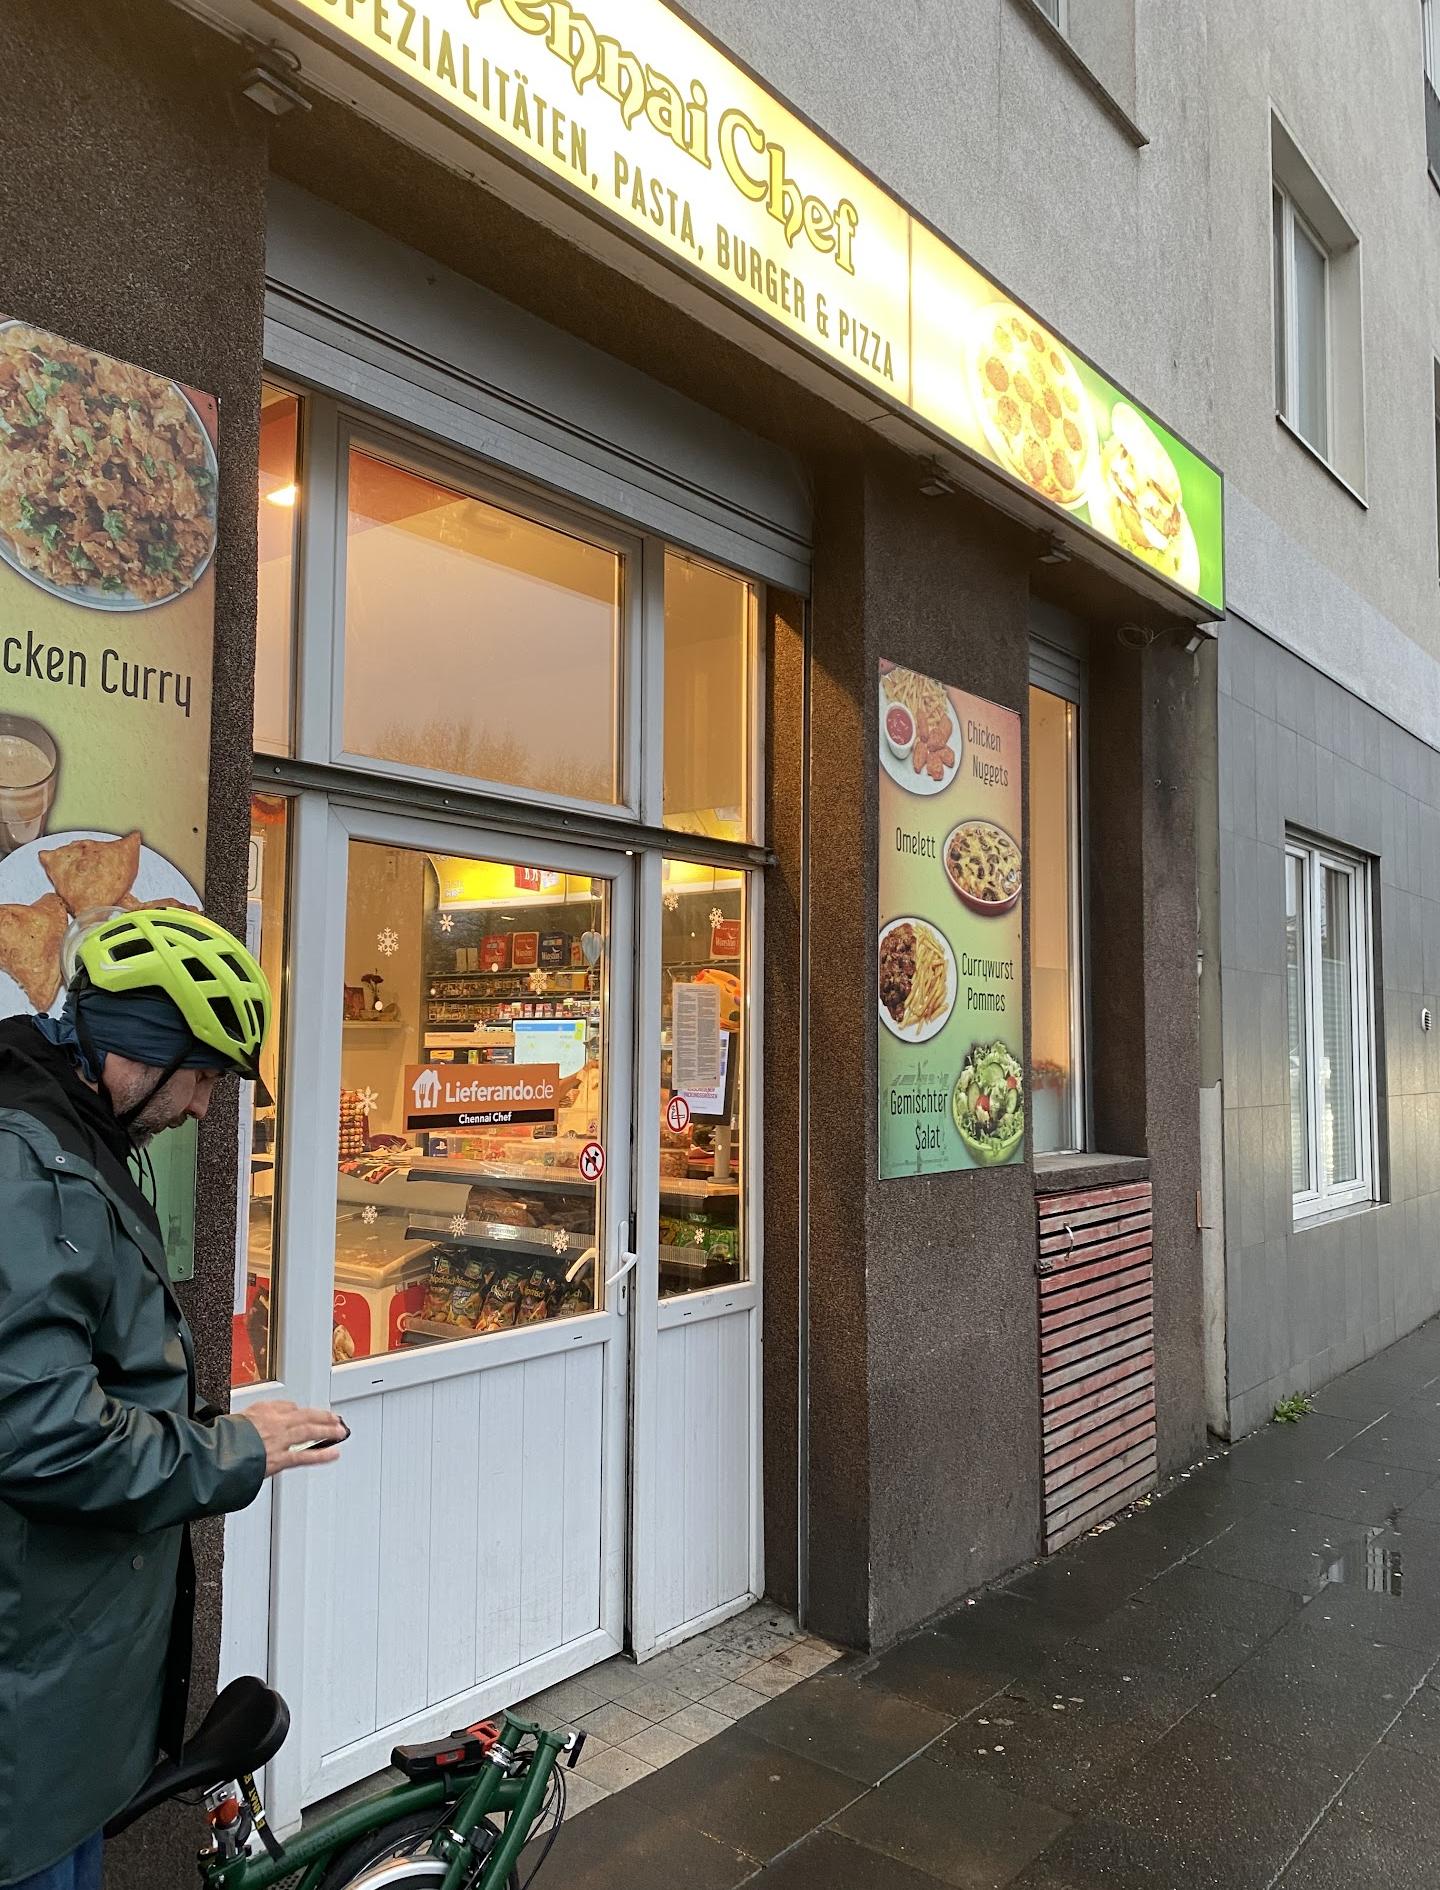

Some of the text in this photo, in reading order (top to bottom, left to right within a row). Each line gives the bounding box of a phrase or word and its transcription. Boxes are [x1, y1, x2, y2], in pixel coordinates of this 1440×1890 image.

[465, 0, 860, 276] ennai Chef
[322, 0, 895, 382] EZIALITÄTEN, PASTA, BURGER & PIZZA
[3, 630, 192, 717] cken Curry
[967, 720, 1001, 752] Chicken
[972, 755, 1009, 787] Nuggets
[896, 827, 936, 858] Omelett
[962, 952, 1014, 982] Currywurst
[967, 987, 1006, 1012] Pommes
[445, 1079, 554, 1103] Lieferando.de
[890, 1088, 948, 1115] Gemischter
[458, 1111, 513, 1124] Chennai Chef
[915, 1124, 941, 1150] Salat
